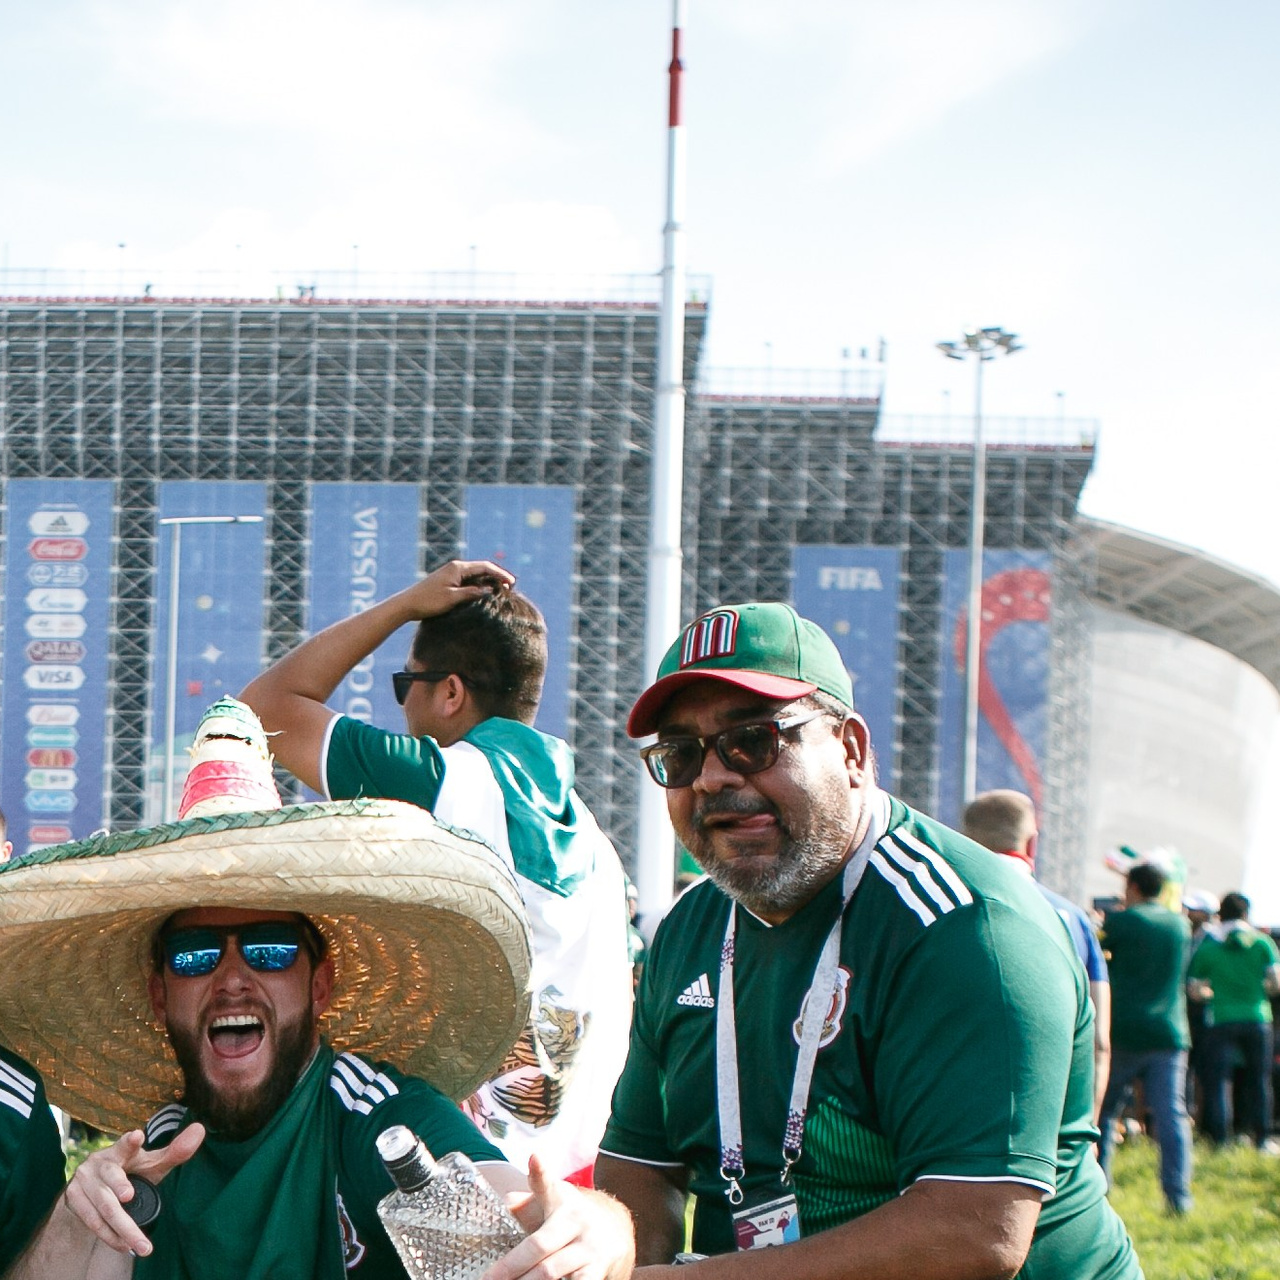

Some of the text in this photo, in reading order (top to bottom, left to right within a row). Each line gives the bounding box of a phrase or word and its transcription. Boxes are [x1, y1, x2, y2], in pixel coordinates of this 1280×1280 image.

[350, 507, 378, 614] RUSSIA
[819, 567, 883, 591] FIFA
[37, 670, 73, 684] VISA
[677, 994, 715, 1008] adidas
